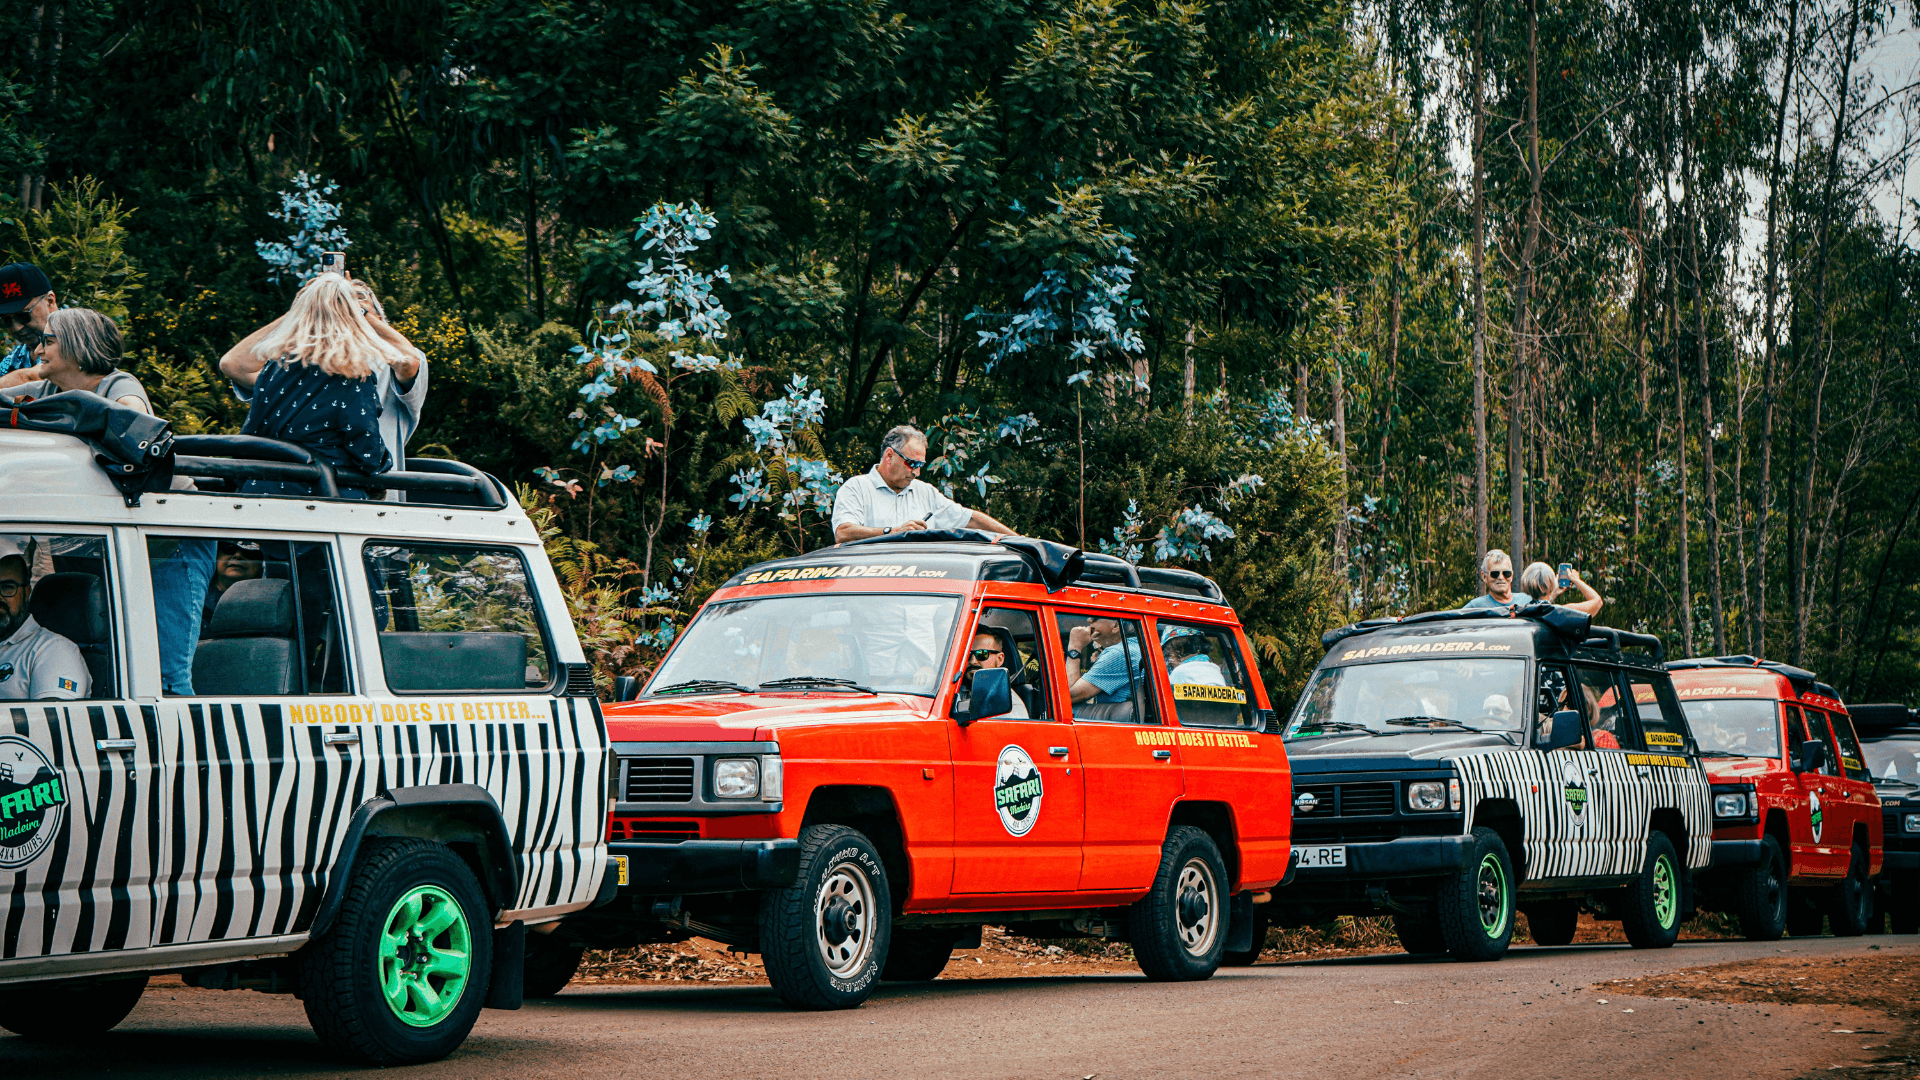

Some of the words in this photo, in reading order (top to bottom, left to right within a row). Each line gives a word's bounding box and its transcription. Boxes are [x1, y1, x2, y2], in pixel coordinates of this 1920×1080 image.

[1183, 686, 1207, 698] SAFARI
[1207, 687, 1236, 700] MADEIRA
[289, 704, 374, 723] NOBODY
[380, 703, 433, 722] DOES
[437, 703, 455, 721] IT
[461, 701, 545, 721] BETTER...
[1134, 731, 1176, 745] NOBODY
[1177, 732, 1204, 746] DOES
[1204, 732, 1215, 747] IT
[997, 777, 1042, 806] SAFARI
[0, 819, 40, 841] Madeira
[17, 833, 43, 858] TOURS
